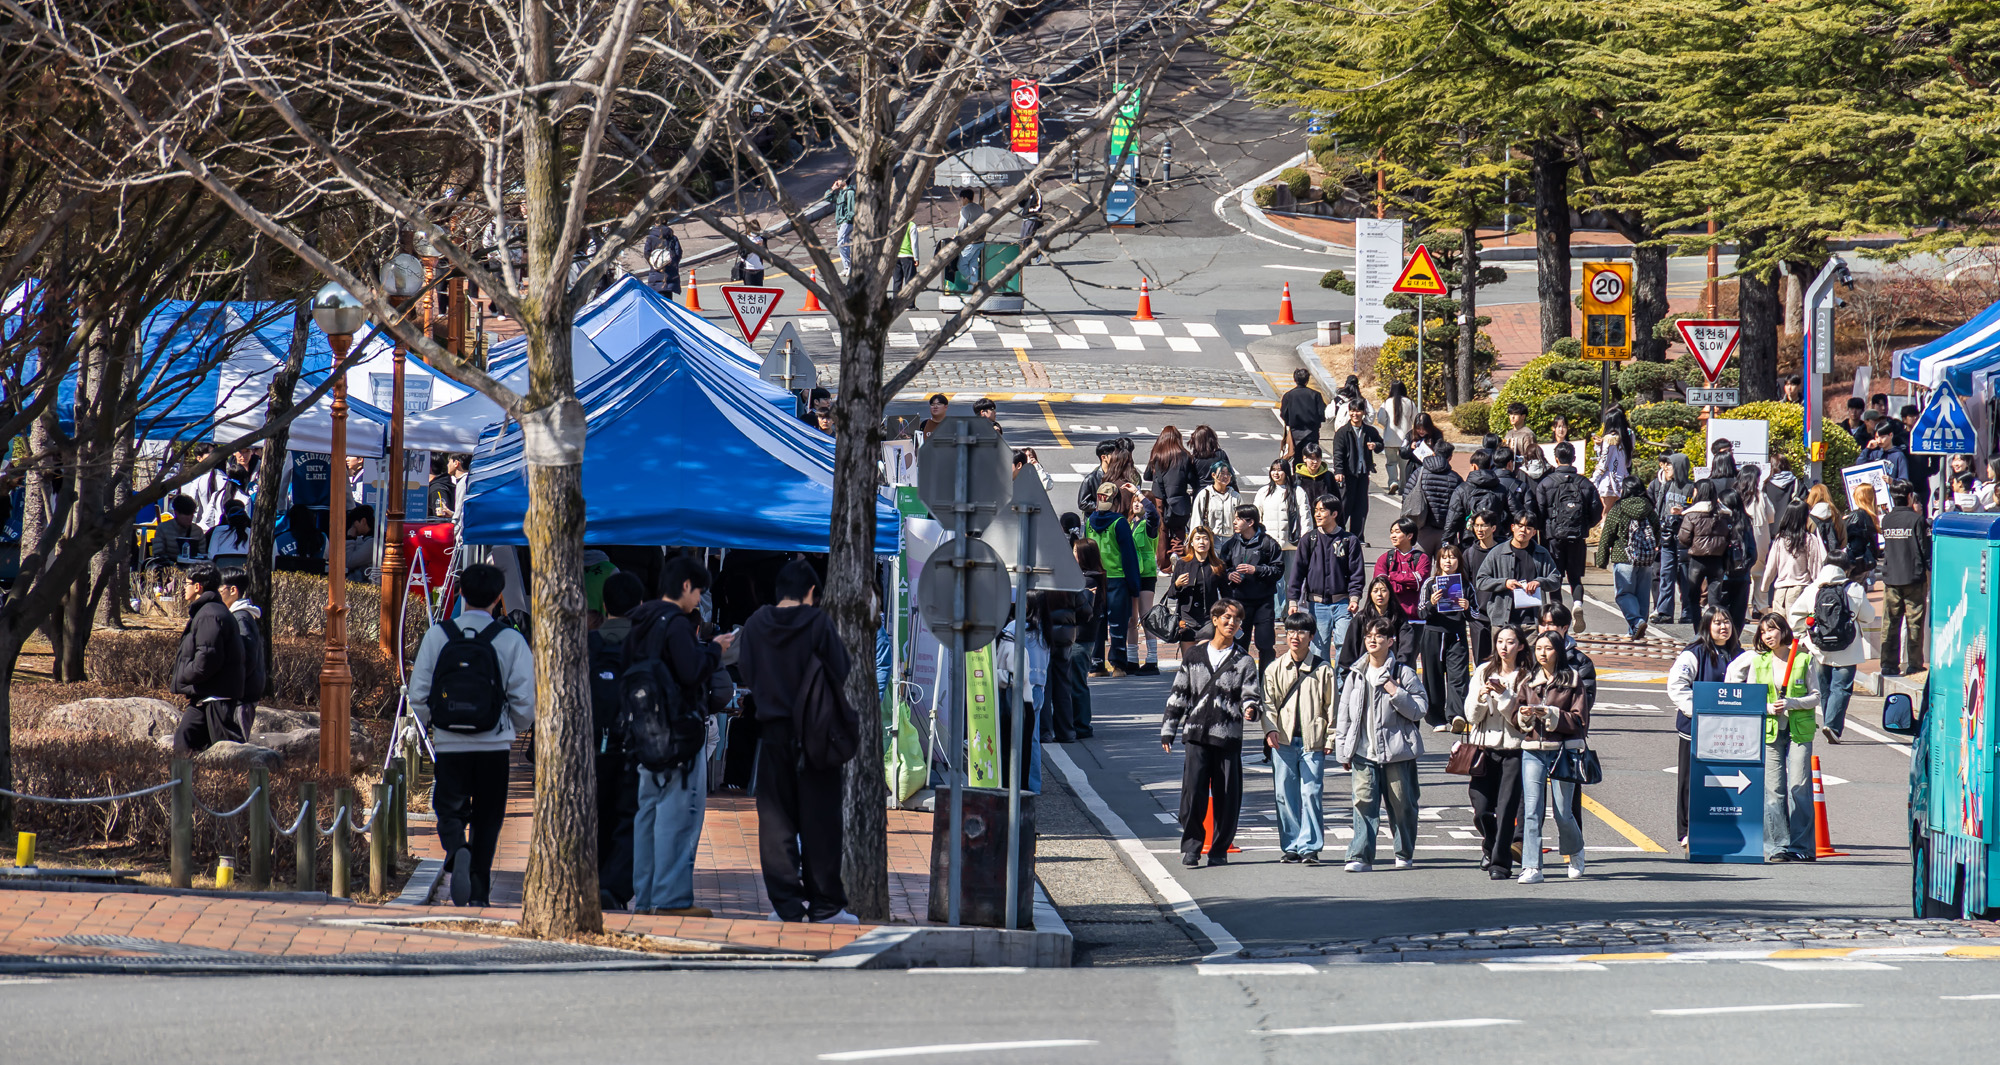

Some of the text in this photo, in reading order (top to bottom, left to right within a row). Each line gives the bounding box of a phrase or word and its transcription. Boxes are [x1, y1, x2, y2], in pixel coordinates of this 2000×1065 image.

[1596, 279, 1619, 295] 20
[737, 294, 766, 305] 천천히
[741, 306, 763, 314] SLOW
[1817, 312, 1826, 339] CCTV
[1695, 328, 1727, 340] 천천히
[1700, 342, 1723, 350] SLOW
[1586, 348, 1628, 357] 현재속도
[1692, 392, 1735, 402] 교내전역
[1922, 440, 1965, 450] 횡단보도
